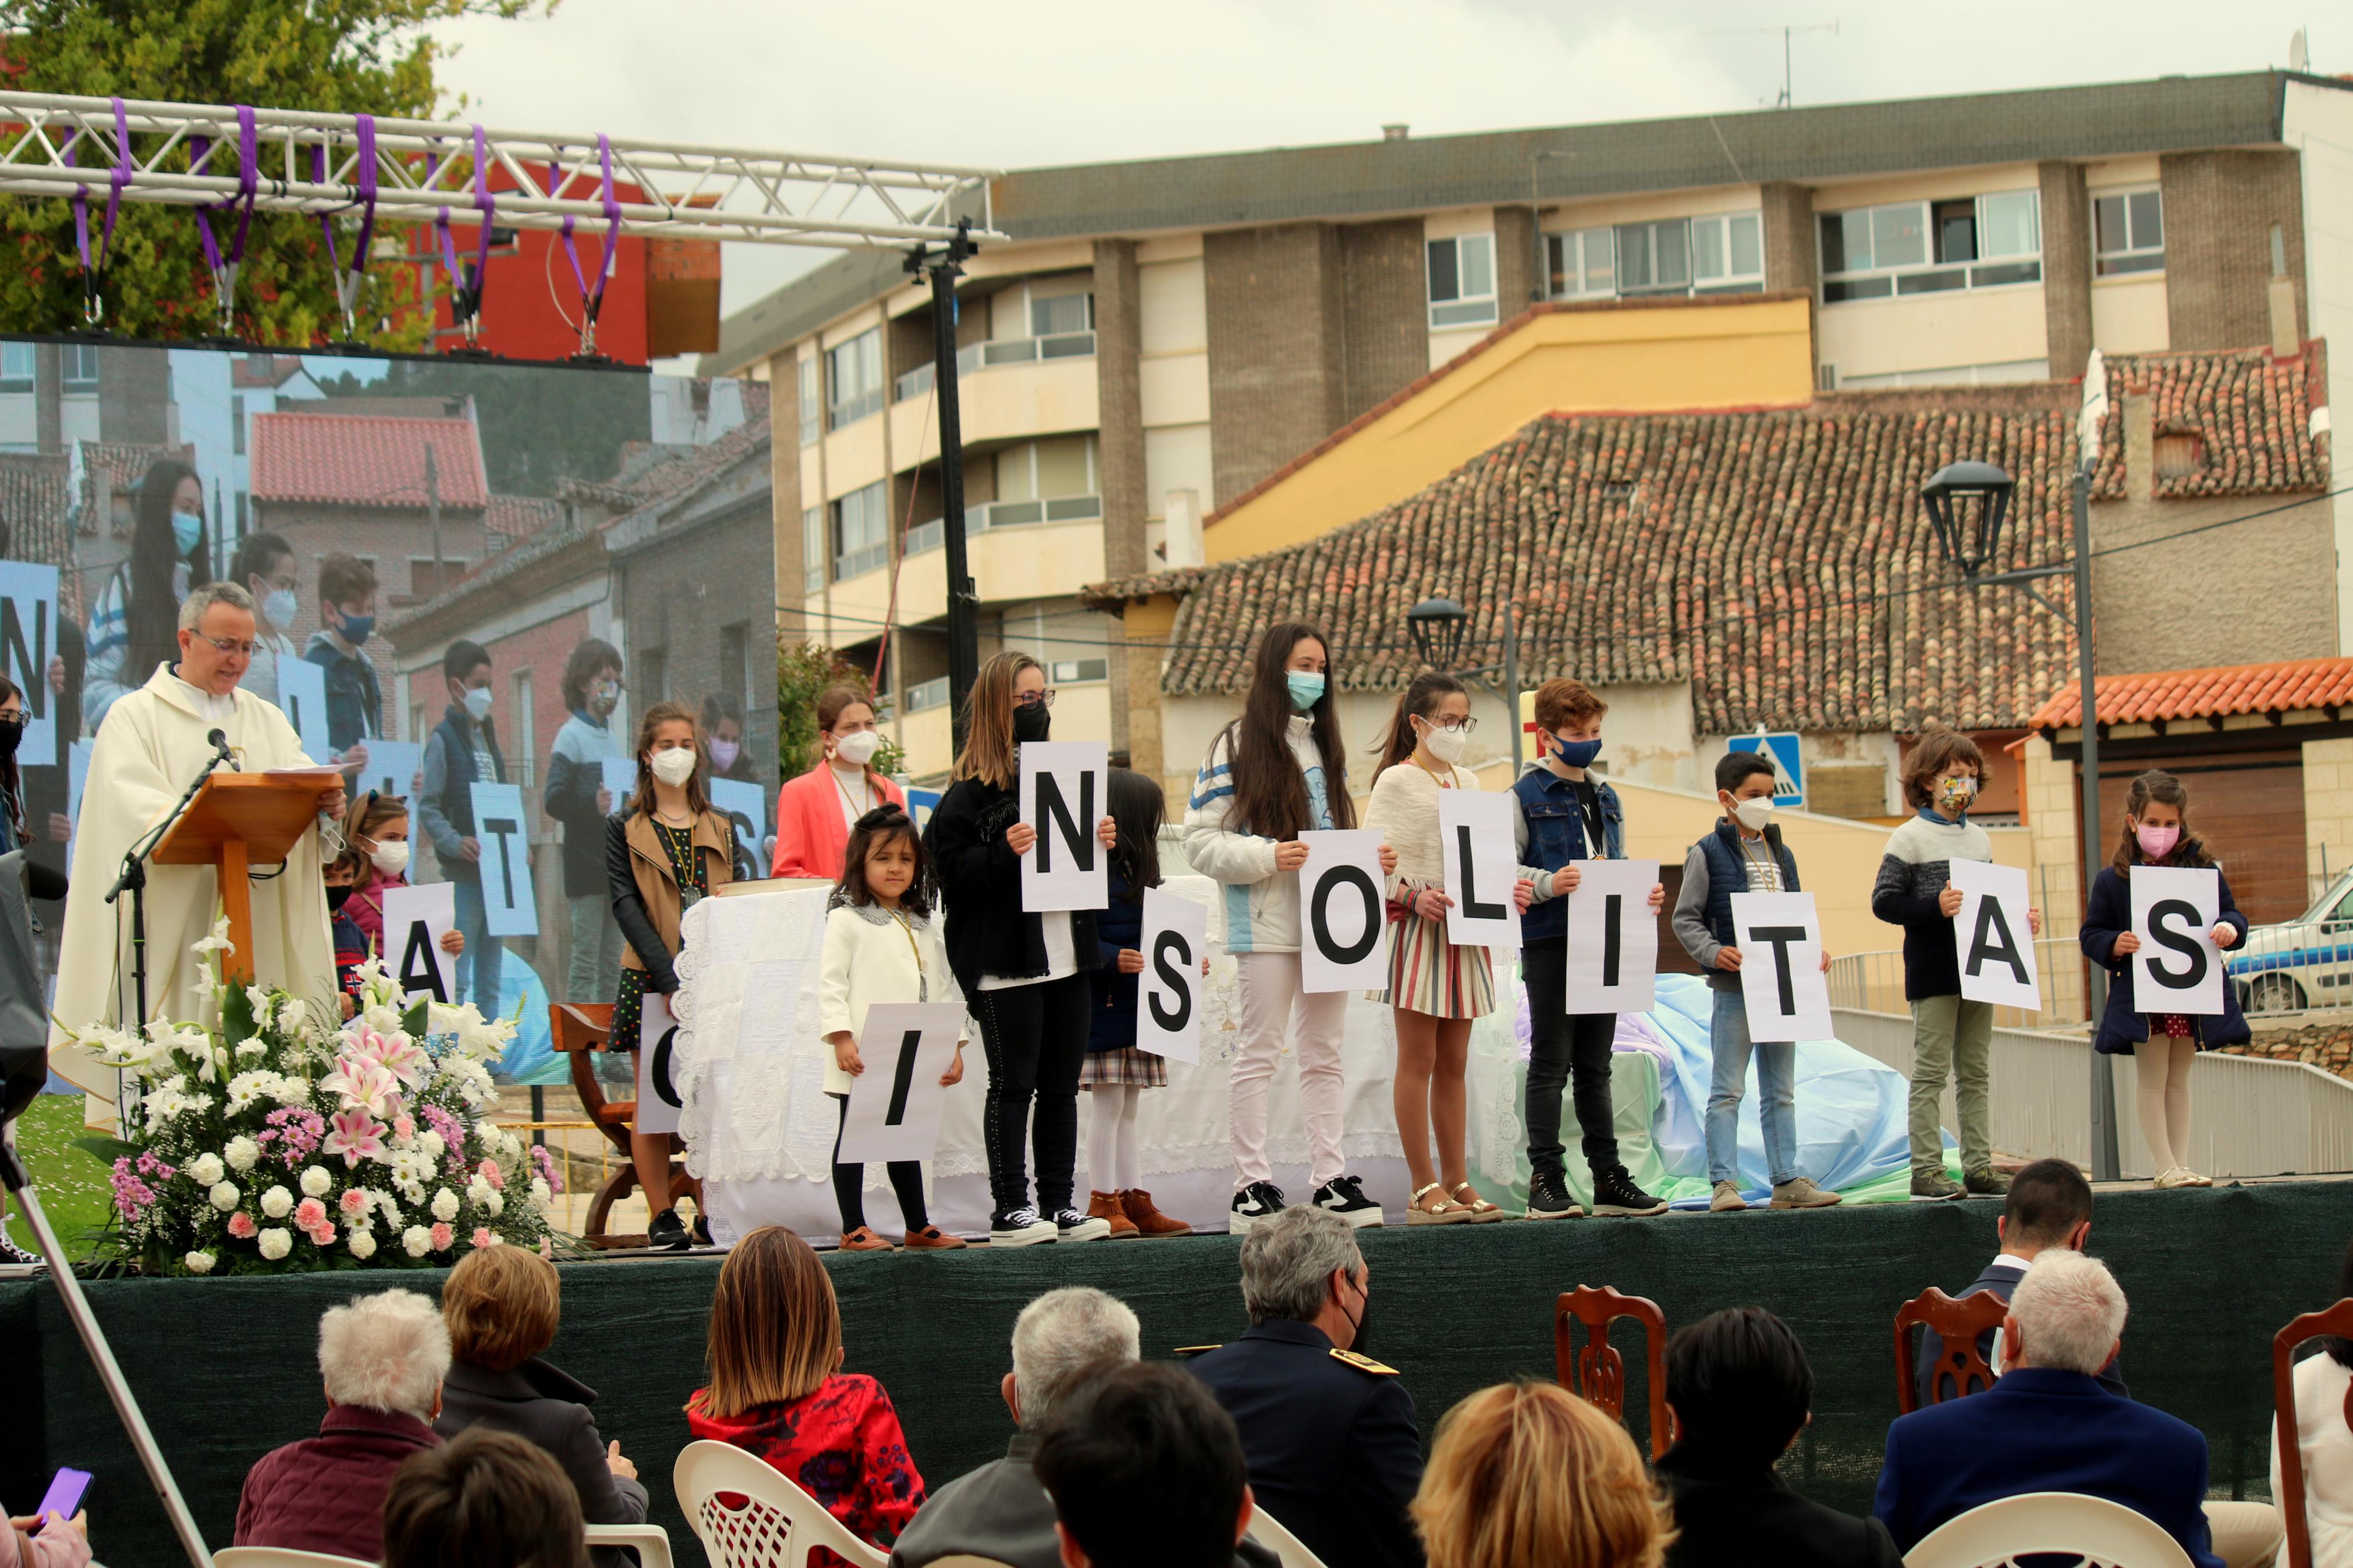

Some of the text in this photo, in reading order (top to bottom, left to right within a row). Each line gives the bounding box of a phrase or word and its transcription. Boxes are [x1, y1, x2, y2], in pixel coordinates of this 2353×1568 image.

[0, 596, 47, 720] N
[482, 819, 517, 909] T
[1035, 770, 1094, 873] N
[1311, 865, 1381, 965] O
[1457, 826, 1507, 920] L
[399, 919, 449, 1007] A
[1148, 930, 1192, 1032] S
[1603, 894, 1621, 986] I
[1748, 926, 1807, 1015] T
[1965, 894, 2031, 985] A
[2146, 899, 2208, 989] S
[885, 1030, 922, 1126] I
